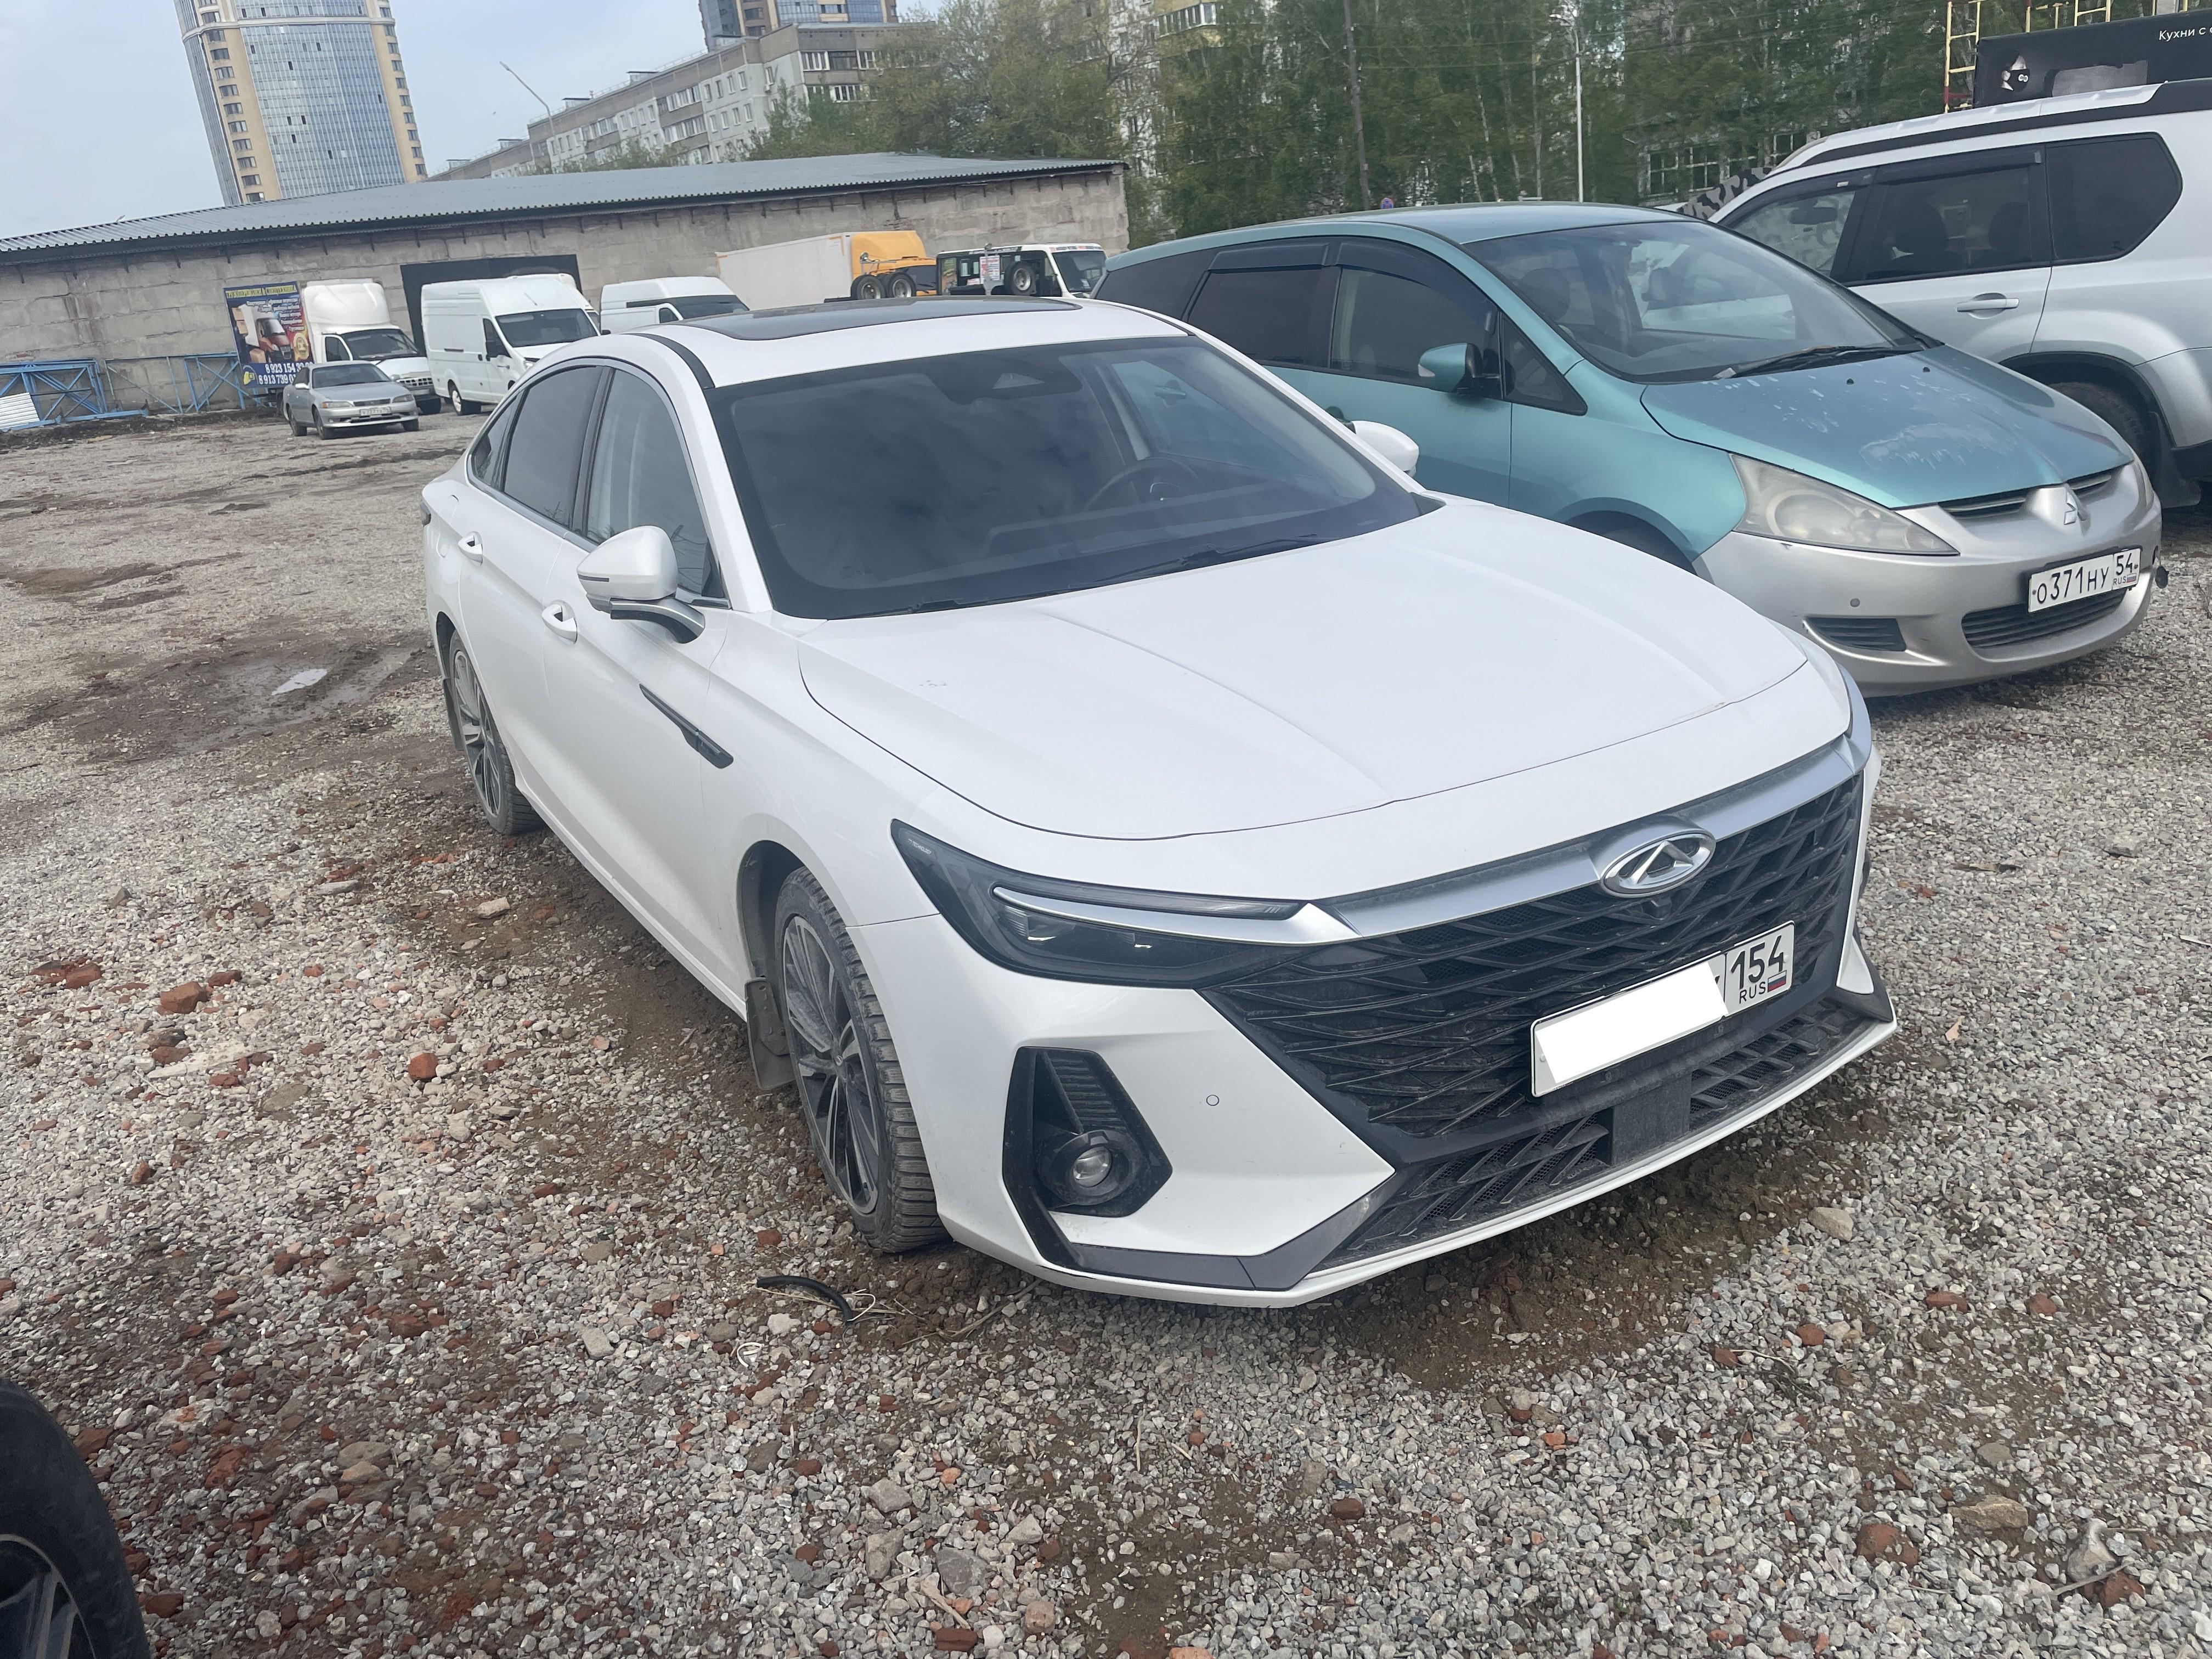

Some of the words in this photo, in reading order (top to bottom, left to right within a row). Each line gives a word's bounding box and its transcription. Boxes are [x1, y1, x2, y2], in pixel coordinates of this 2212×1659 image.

[2159, 29, 2195, 42] Кухни
[2199, 27, 2206, 35] с
[265, 363, 270, 374] 8
[270, 363, 283, 373] 923
[283, 363, 296, 373] 154
[263, 374, 276, 385] 913
[276, 374, 289, 384] 739
[2115, 552, 2133, 575] 54
[2113, 575, 2127, 586] RUS
[1730, 935, 1784, 990] 154
[1739, 981, 1766, 1004] RUS
